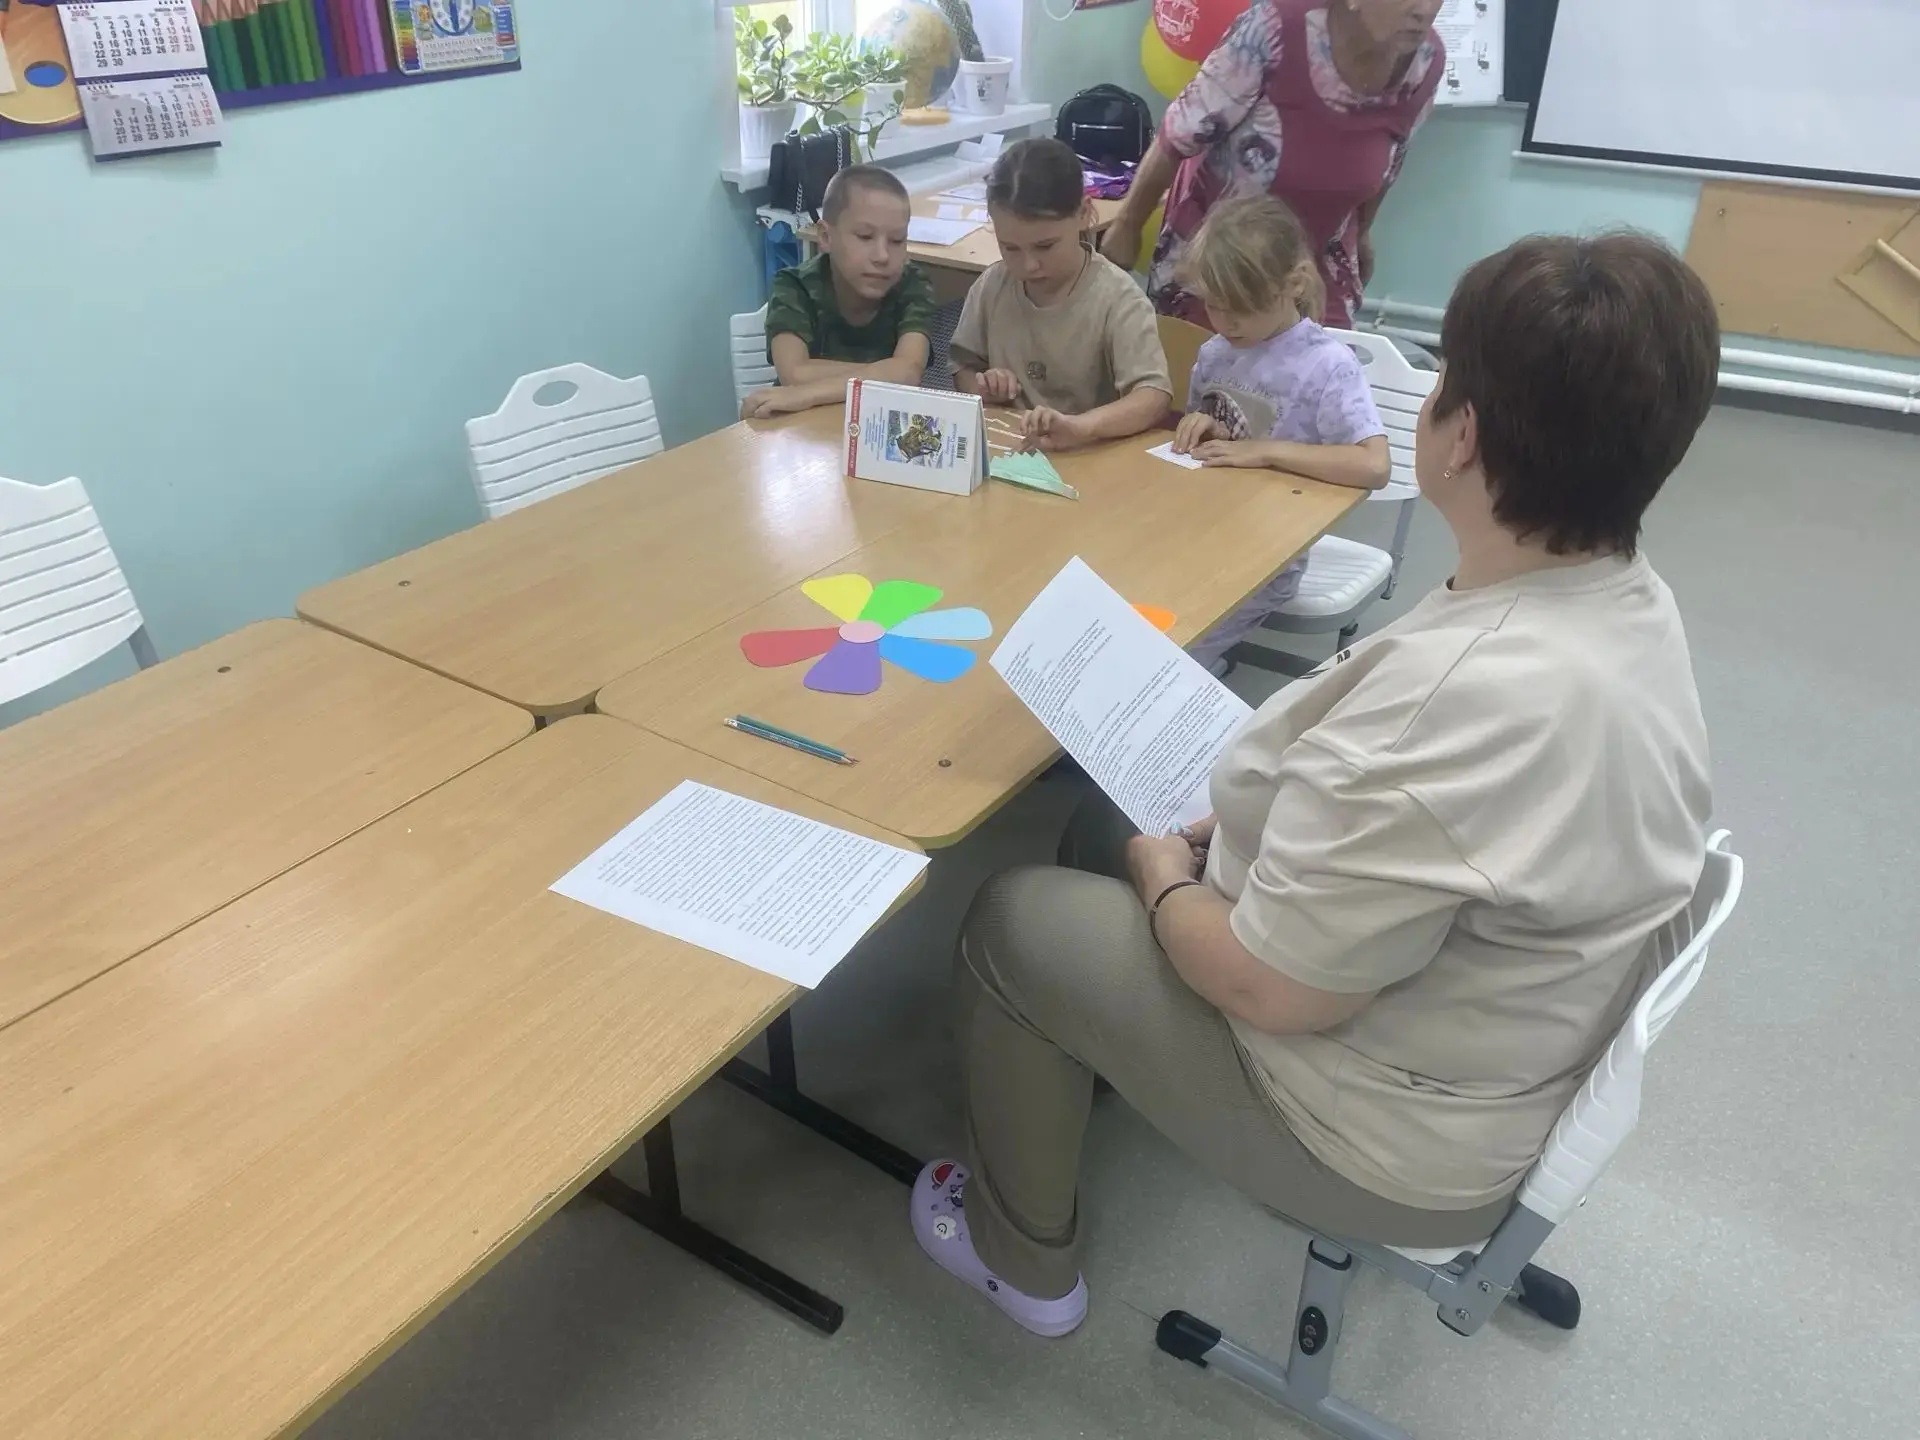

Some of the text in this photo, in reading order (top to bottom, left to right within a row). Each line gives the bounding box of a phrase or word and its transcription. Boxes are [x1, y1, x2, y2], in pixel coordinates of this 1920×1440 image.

[93, 22, 99, 30] 1
[108, 21, 115, 29] 2
[124, 20, 130, 28] 3
[140, 19, 145, 27] 4
[154, 17, 160, 26] 5
[95, 31, 102, 40] 8
[111, 30, 117, 38] 9
[122, 29, 132, 37] 10
[138, 28, 147, 36] 11
[93, 40, 104, 49] 15
[109, 39, 119, 48] 16
[124, 38, 133, 47] 17
[140, 37, 150, 46] 18
[155, 36, 164, 44] 19
[95, 50, 106, 58] 22
[110, 49, 121, 57] 23
[126, 48, 137, 56] 24
[140, 46, 152, 55] 25
[156, 45, 166, 54] 26
[96, 57, 124, 68] 29 30
